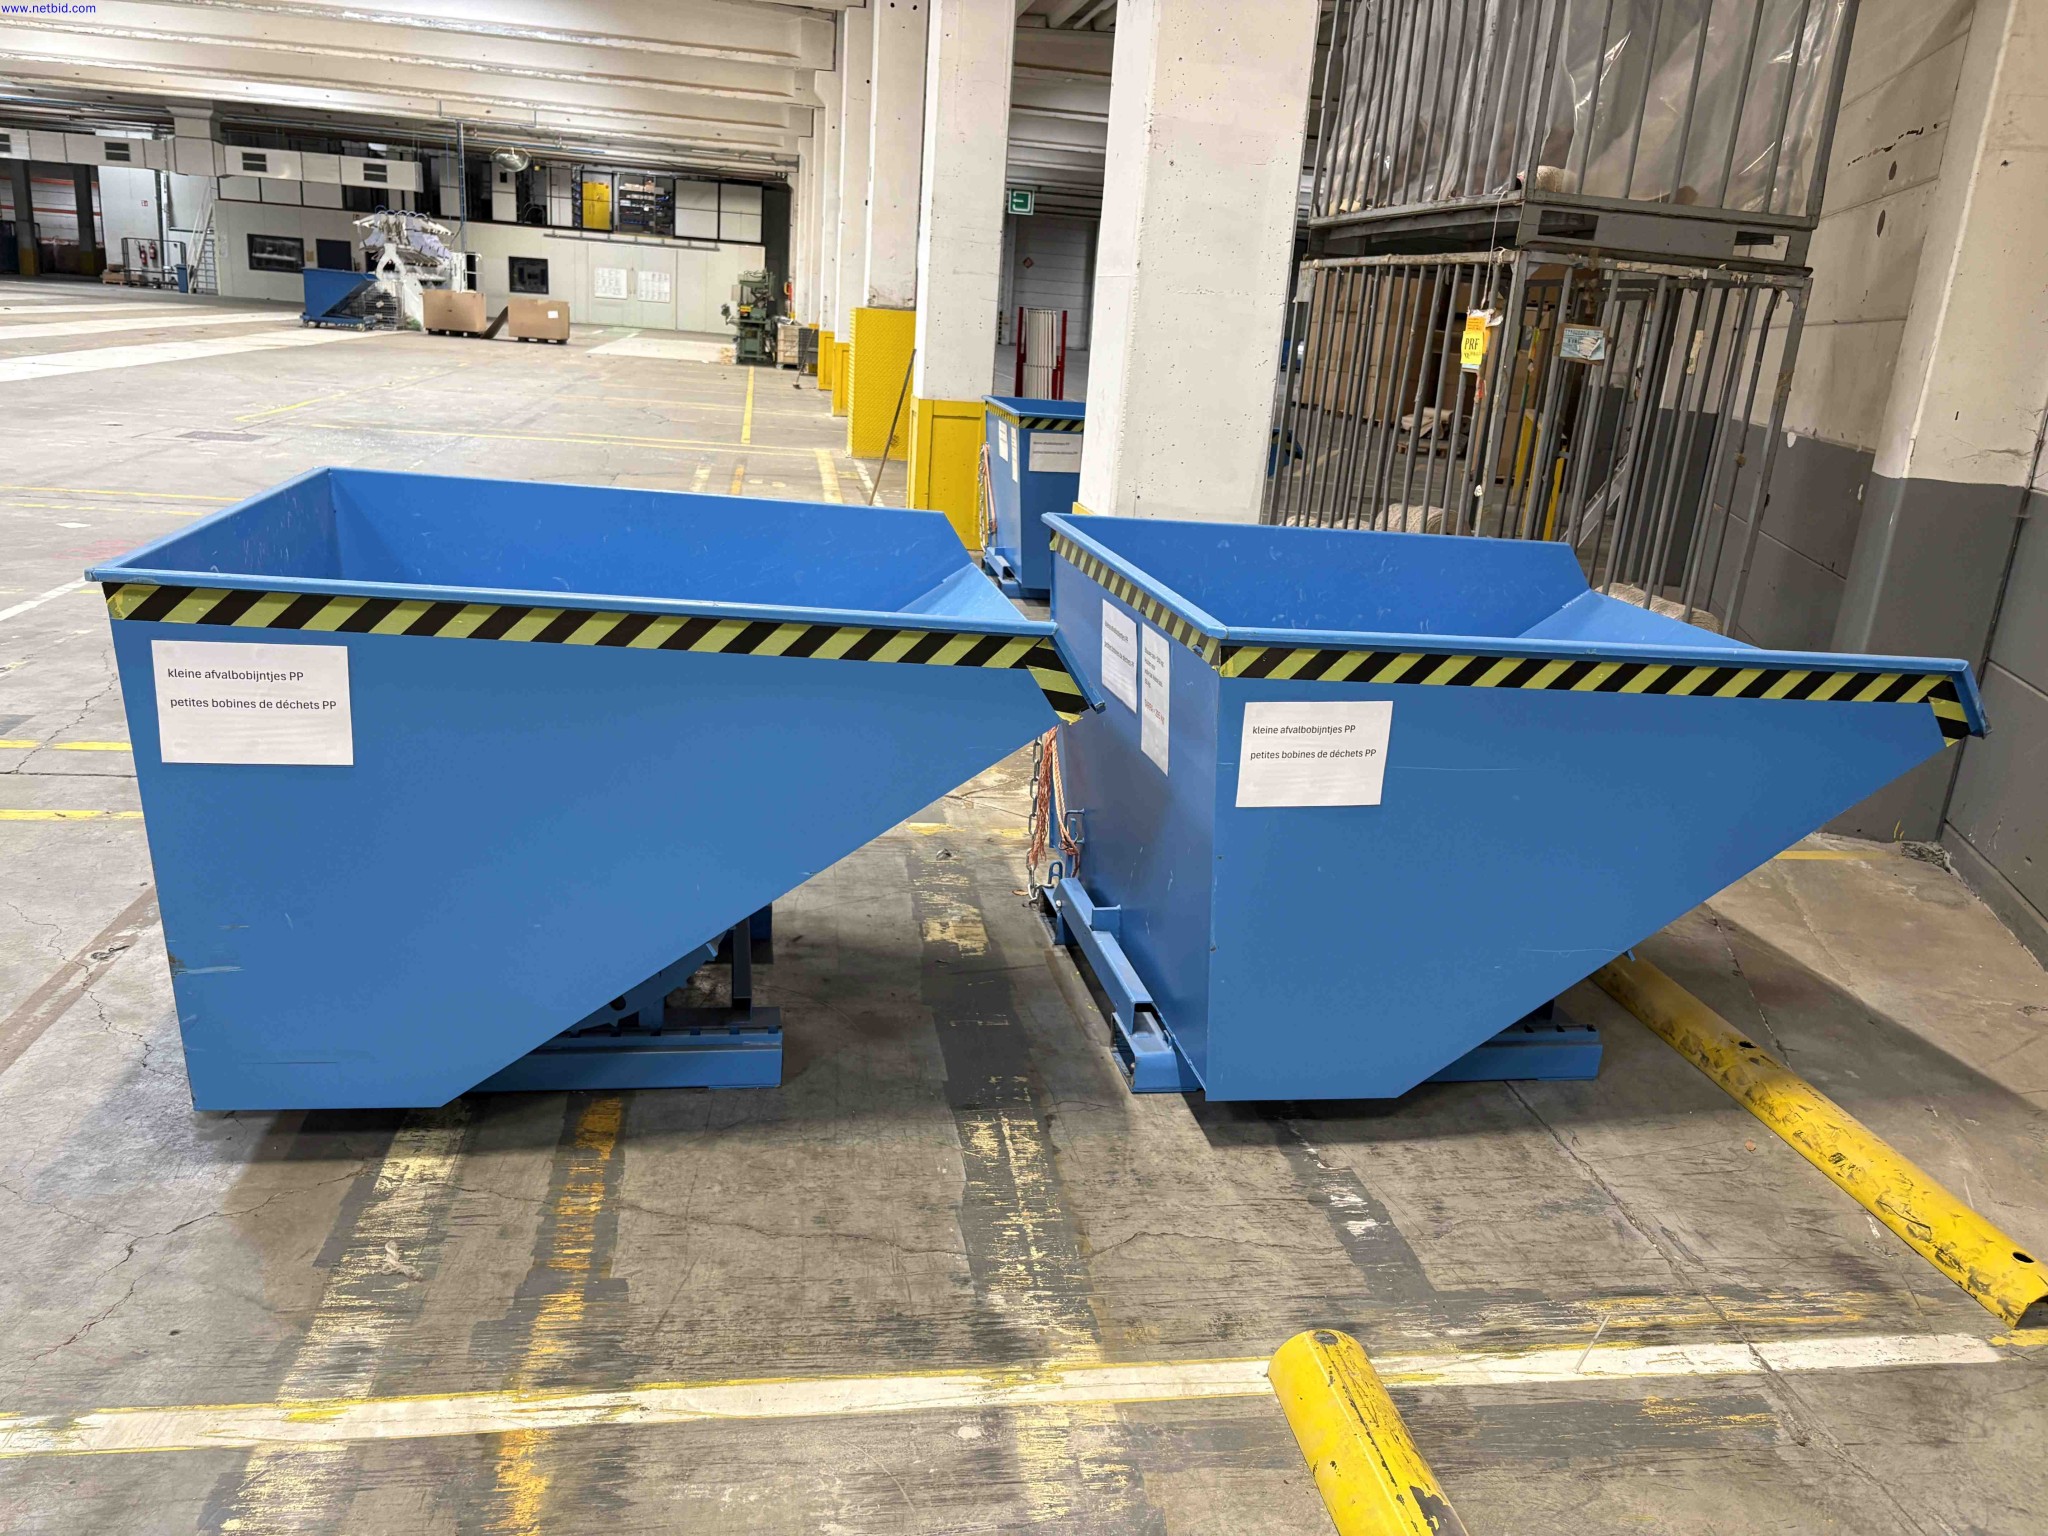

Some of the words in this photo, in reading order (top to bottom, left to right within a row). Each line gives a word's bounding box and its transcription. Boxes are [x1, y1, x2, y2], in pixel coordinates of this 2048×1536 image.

[167, 668, 202, 679] kleine
[204, 669, 287, 682] afvalbobijntjes
[289, 671, 304, 681] PP
[170, 698, 209, 709] petites
[211, 698, 257, 708] bobines
[259, 699, 273, 709] de
[275, 699, 320, 709] déchets
[322, 700, 337, 710] PP
[1252, 725, 1279, 735] kleine
[1280, 725, 1343, 736] afvalbobijntjes
[1344, 724, 1356, 733] PP
[1250, 750, 1280, 761] petites
[1281, 750, 1316, 759] bobines
[1317, 749, 1328, 758] de
[1329, 749, 1363, 758] déchets
[1365, 748, 1377, 757] PP
